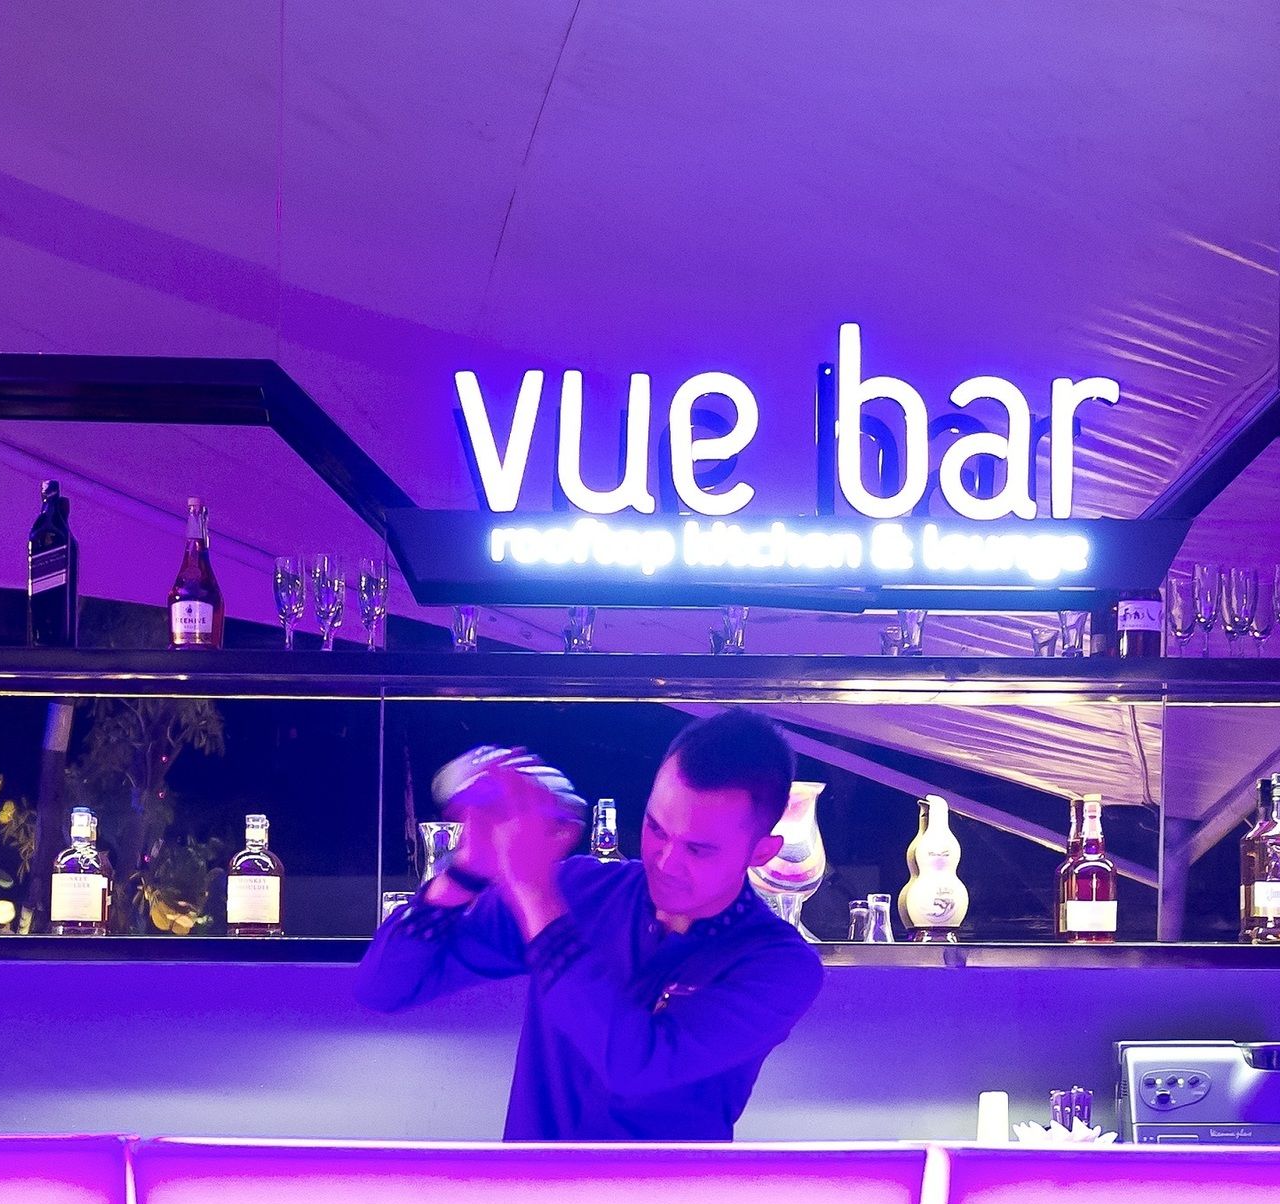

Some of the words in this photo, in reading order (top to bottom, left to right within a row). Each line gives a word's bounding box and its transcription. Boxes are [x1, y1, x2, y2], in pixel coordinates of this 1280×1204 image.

[454, 369, 759, 516] vue
[839, 322, 1119, 521] bar
[490, 518, 675, 575] rooftop
[683, 520, 862, 567] kitchen
[870, 523, 914, 570] &
[922, 523, 1089, 580] lounge
